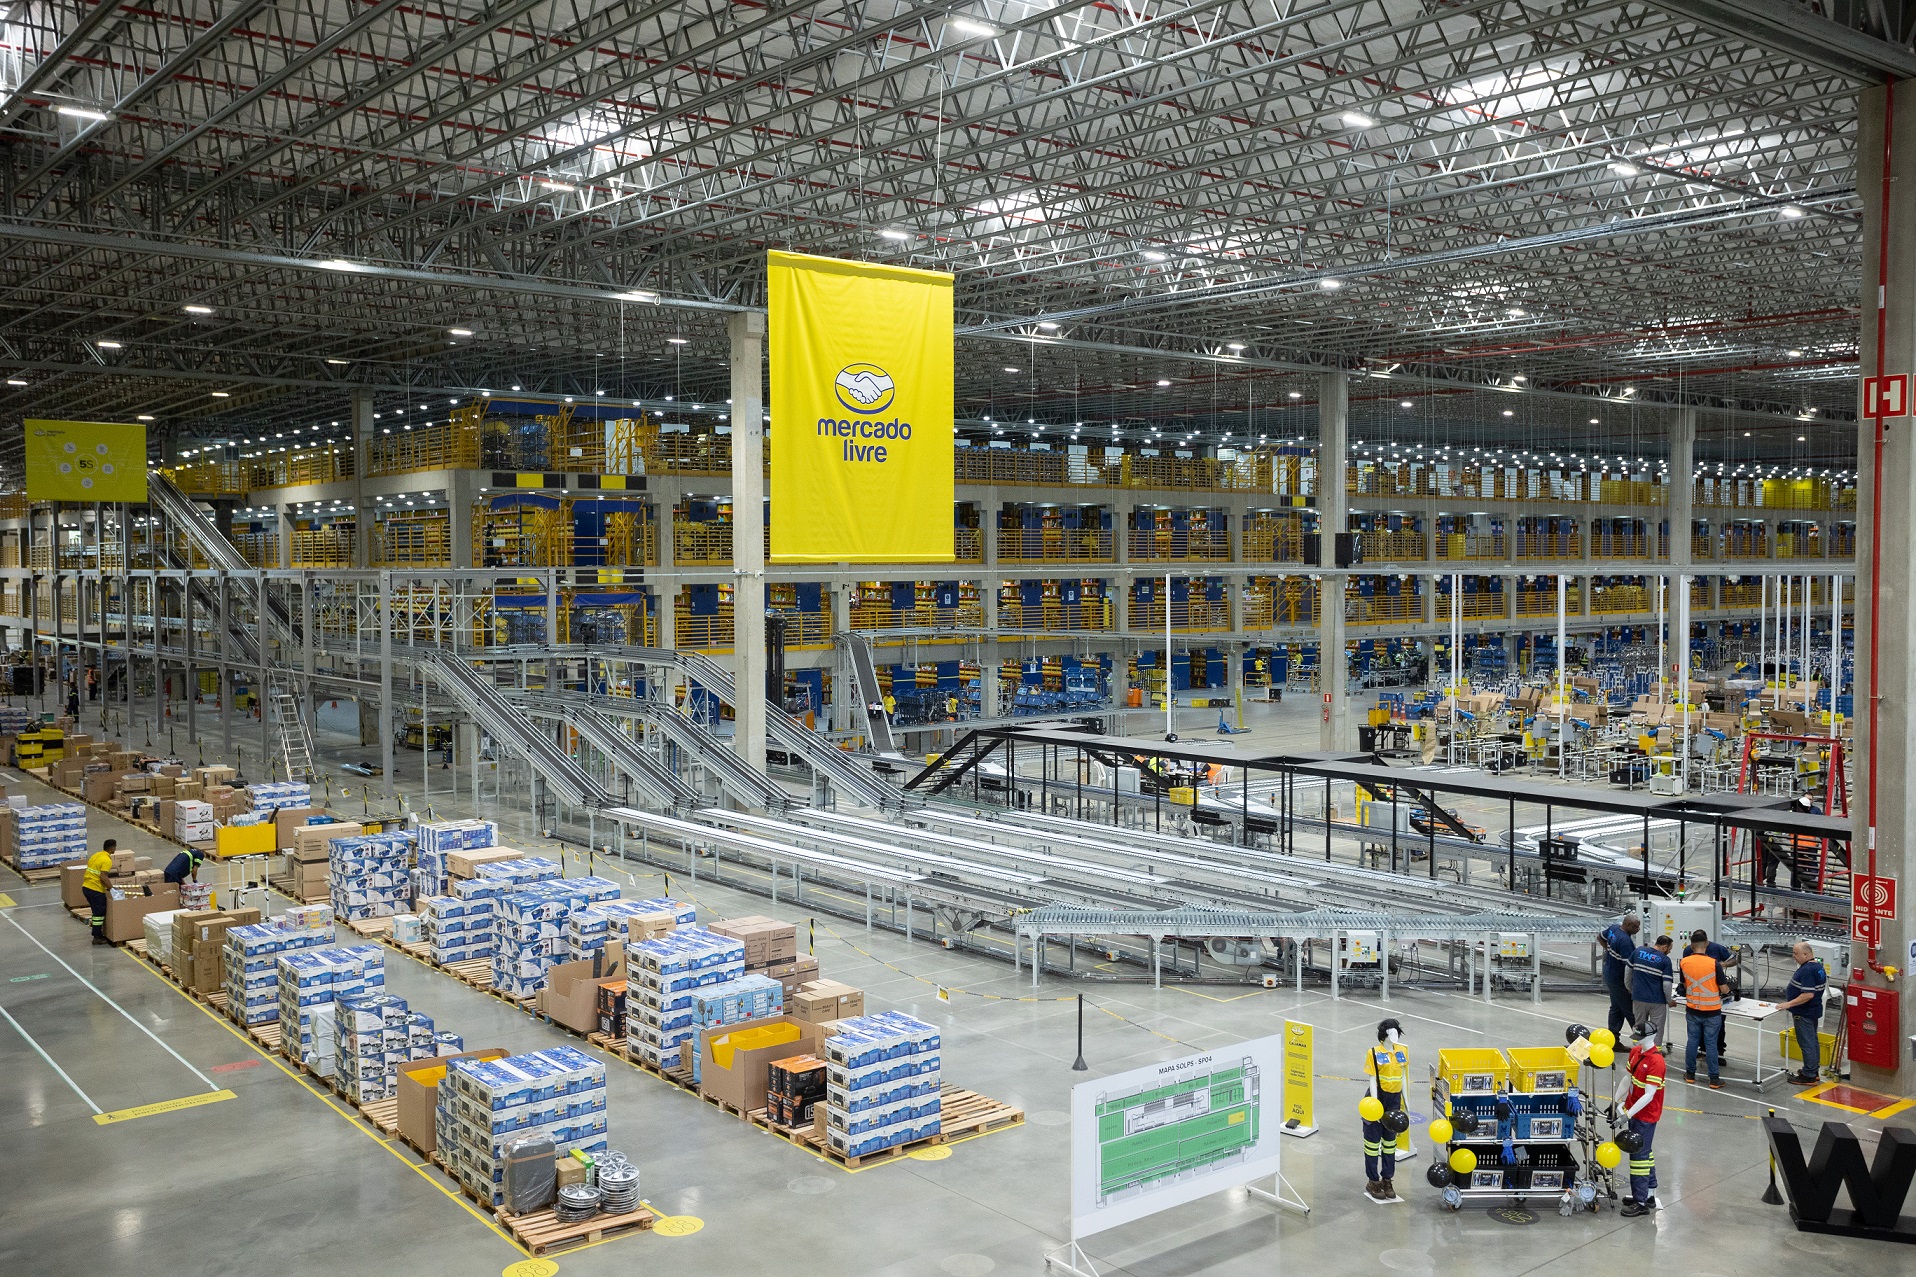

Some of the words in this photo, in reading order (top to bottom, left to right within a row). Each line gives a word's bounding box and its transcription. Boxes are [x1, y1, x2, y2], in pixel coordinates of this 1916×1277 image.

[817, 418, 912, 440] mercado
[843, 439, 888, 463] livre
[80, 460, 94, 468] 5S
[1856, 905, 1892, 916] HIDANTE
[1158, 1065, 1175, 1074] MAPA
[1176, 1060, 1194, 1070] SOLPS
[1198, 1056, 1212, 1064] SP04
